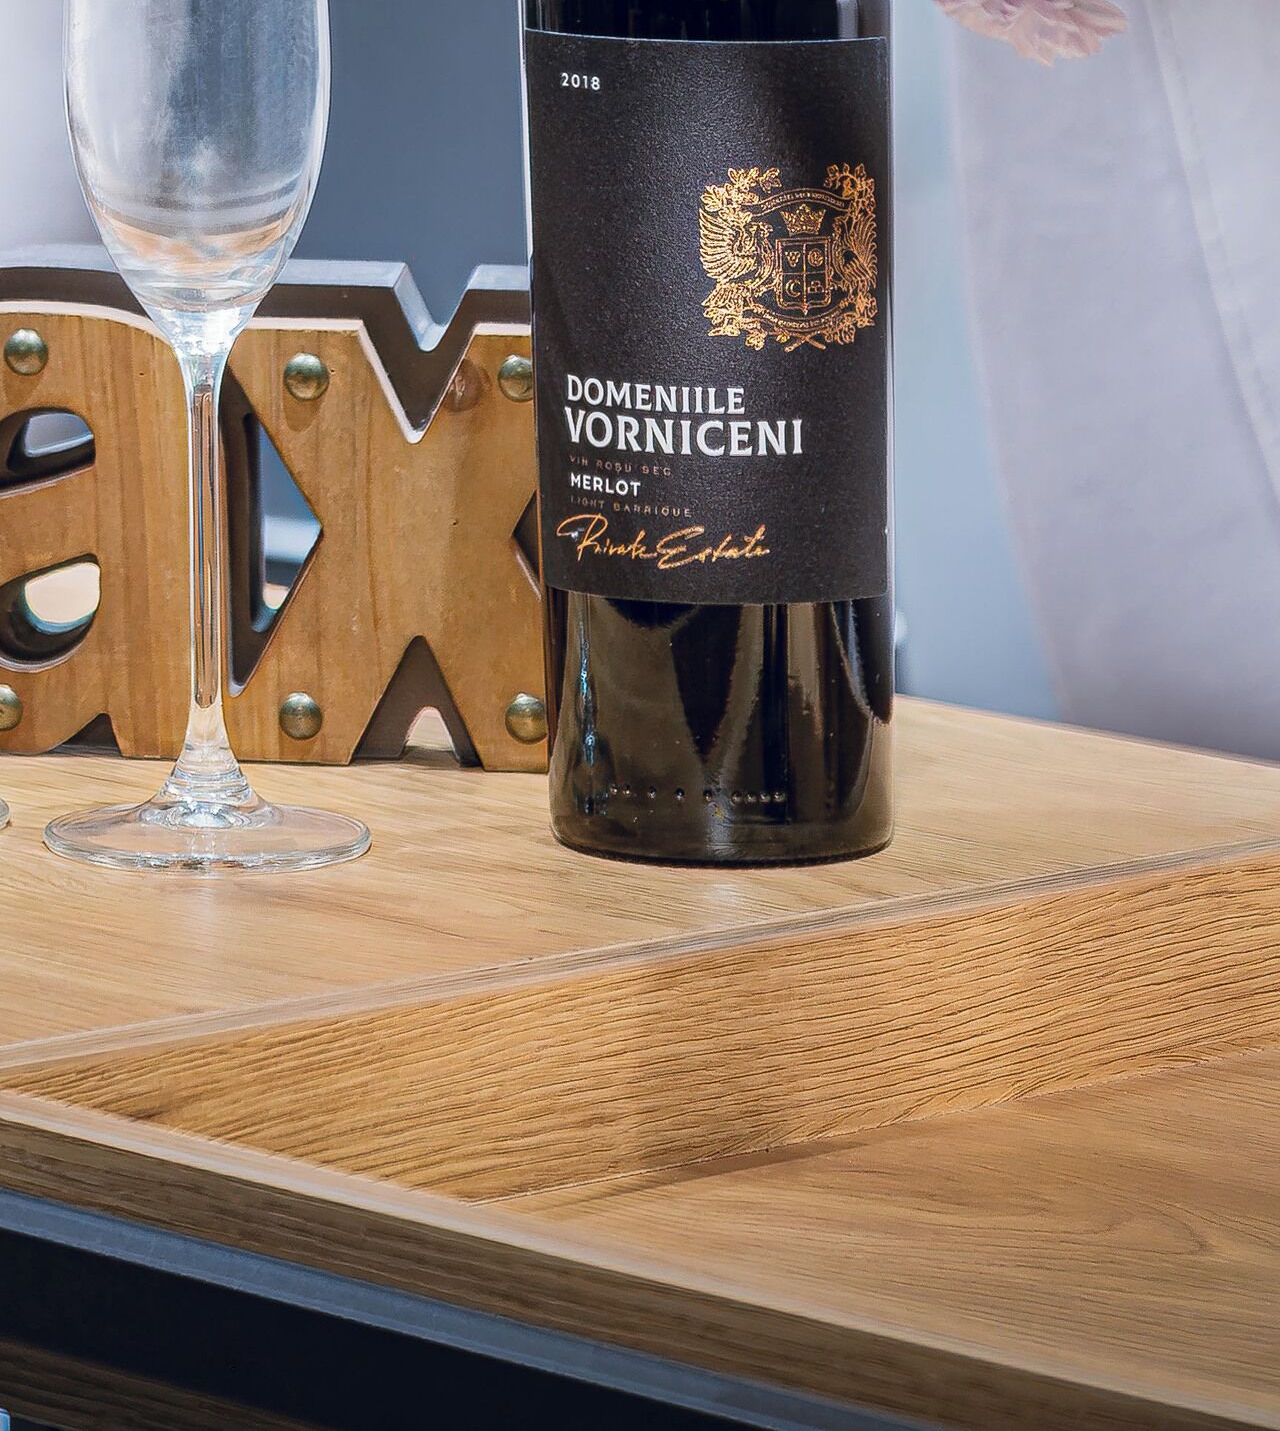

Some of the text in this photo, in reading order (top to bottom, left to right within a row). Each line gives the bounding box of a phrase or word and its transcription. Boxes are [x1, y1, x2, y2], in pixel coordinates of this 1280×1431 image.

[561, 72, 601, 91] 2018
[567, 373, 746, 415] DOMENIILE
[564, 406, 804, 457] VORNICENI
[570, 472, 641, 497] MERLOT
[613, 503, 692, 518] BARRIQUE
[556, 513, 770, 570] Private Estate
